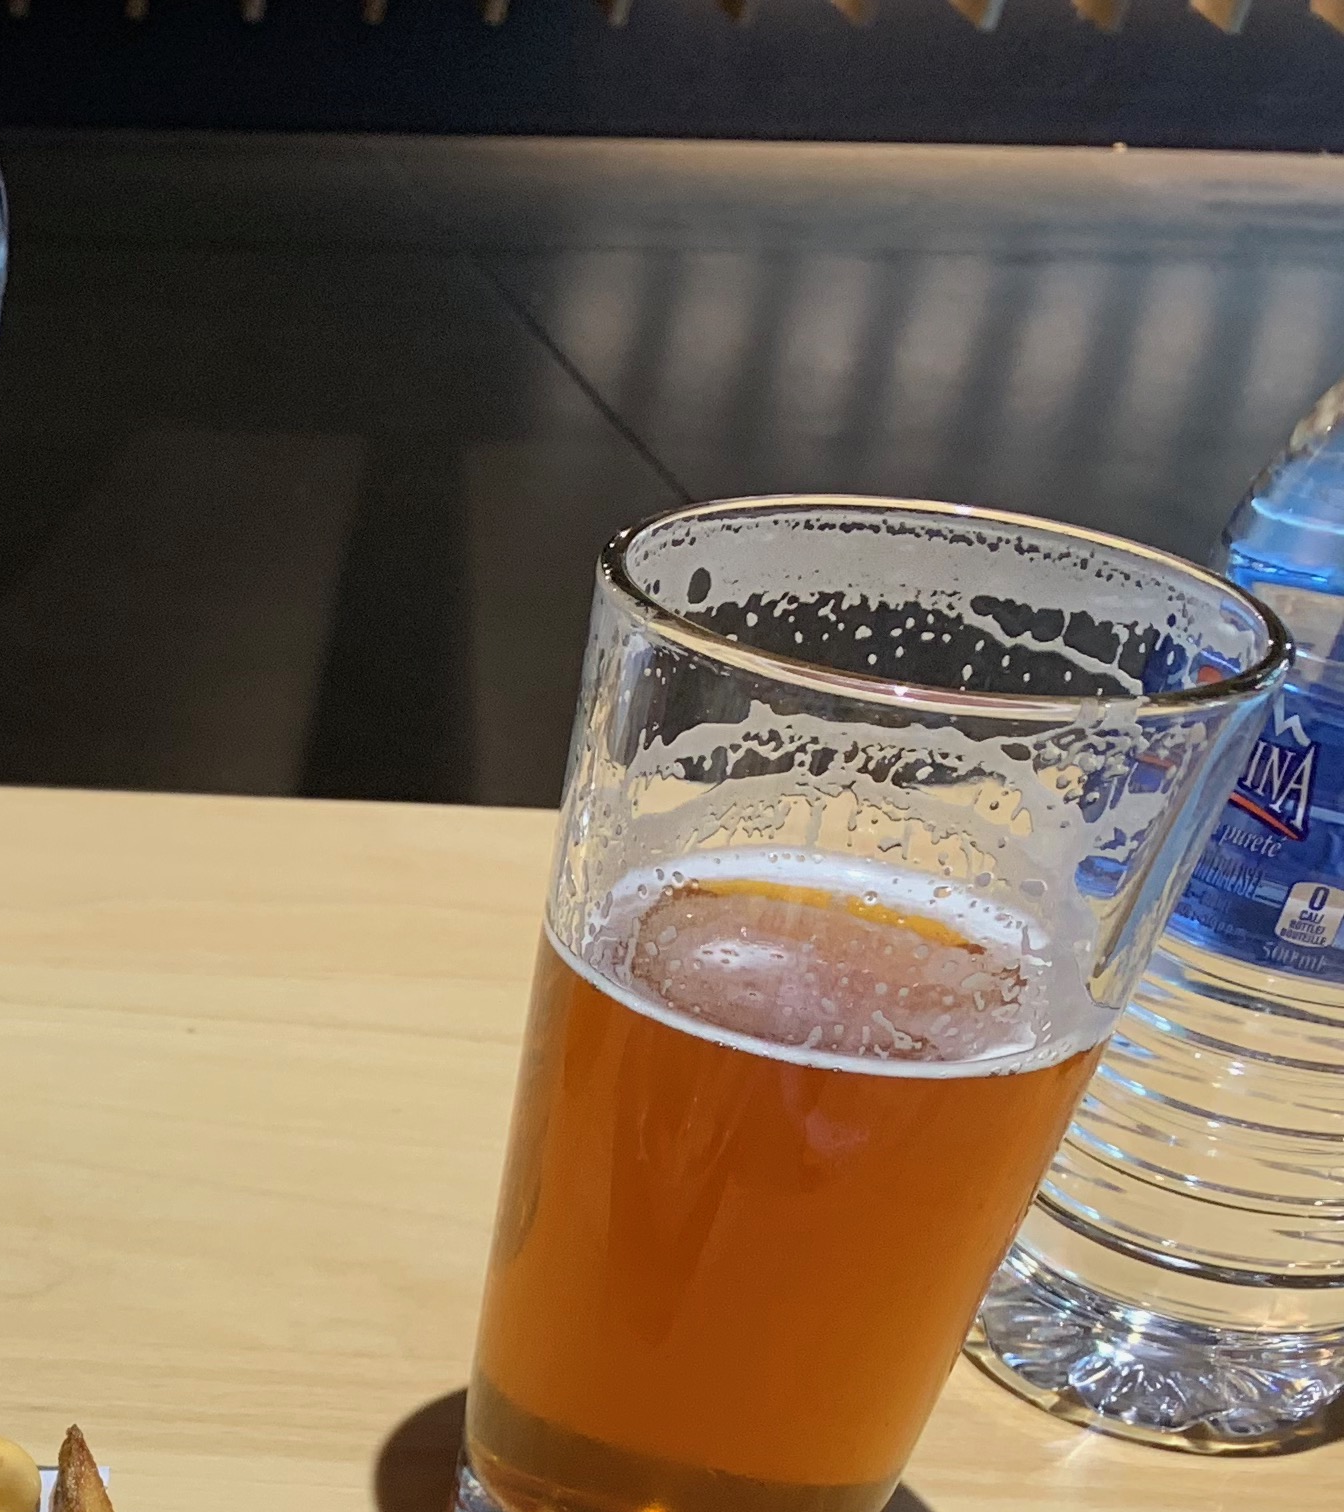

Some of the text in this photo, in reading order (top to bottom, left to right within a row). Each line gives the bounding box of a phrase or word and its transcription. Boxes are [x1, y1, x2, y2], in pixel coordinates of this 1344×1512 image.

[1242, 739, 1316, 832] INA
[1219, 825, 1287, 858] pureté
[1310, 886, 1330, 911] 0
